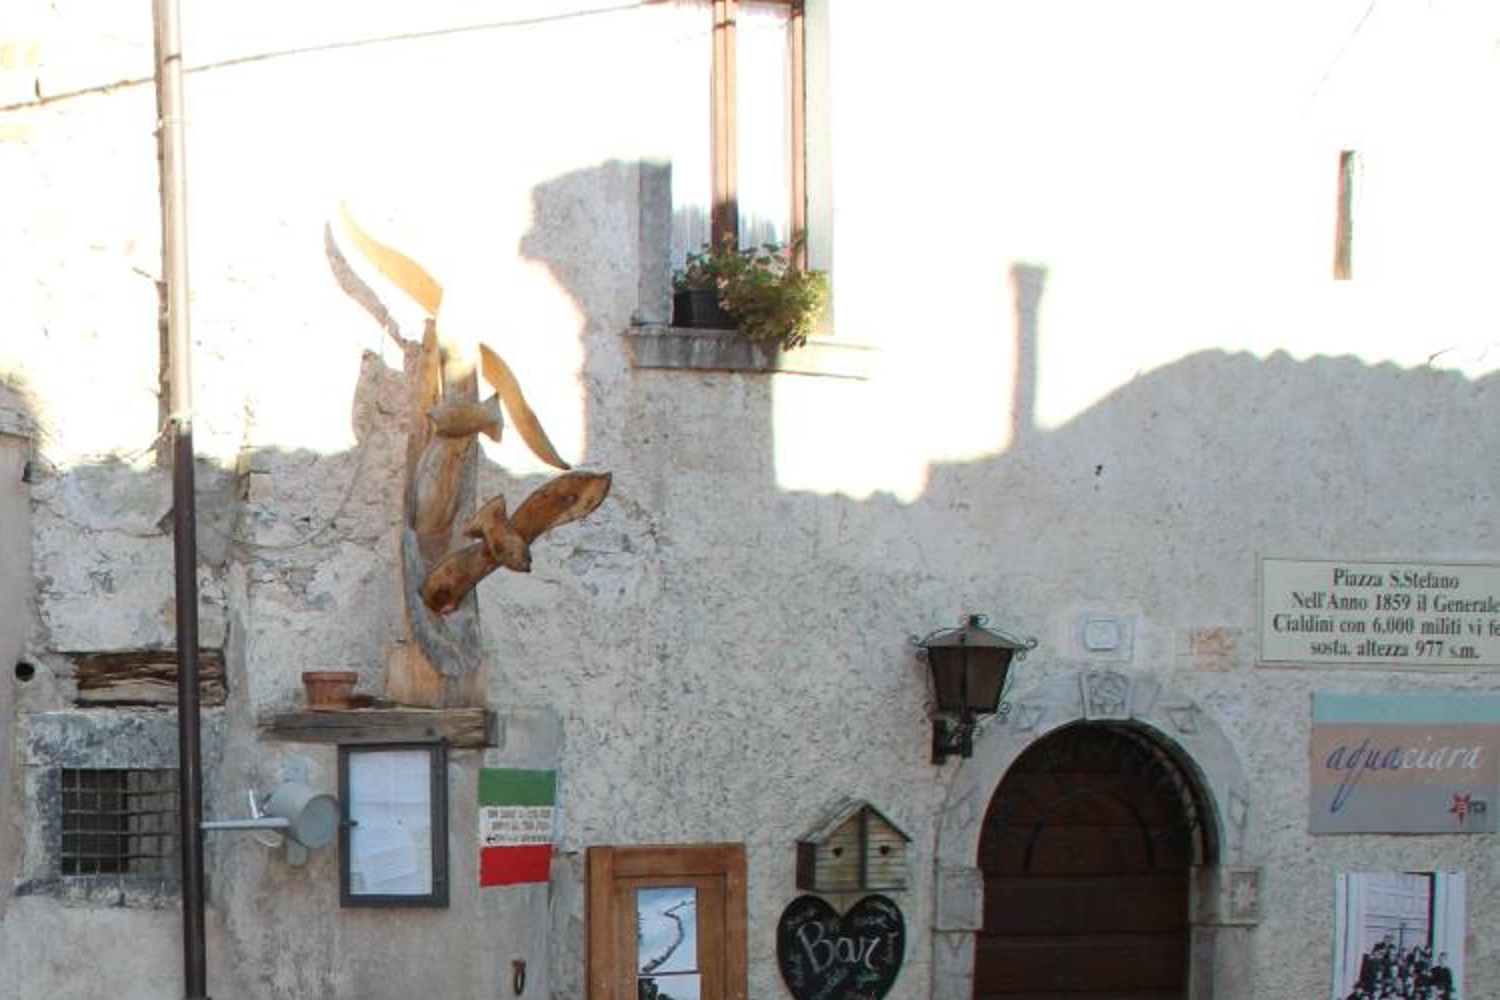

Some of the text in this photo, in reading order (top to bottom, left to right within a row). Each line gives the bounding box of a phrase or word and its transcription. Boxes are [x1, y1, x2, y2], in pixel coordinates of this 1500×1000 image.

[1332, 567, 1461, 590] Piazza S.Stefano
[1375, 593, 1412, 612] 1859
[1417, 595, 1428, 613] il
[1433, 596, 1500, 614] Generale
[1272, 613, 1335, 633] Cialdini
[1339, 620, 1366, 633] con
[1373, 616, 1414, 636] 6.000
[1420, 617, 1462, 636] militi
[1467, 618, 1483, 637] vi
[1356, 639, 1409, 658] altezza
[1415, 640, 1444, 659] 977
[796, 921, 881, 974] Bar
